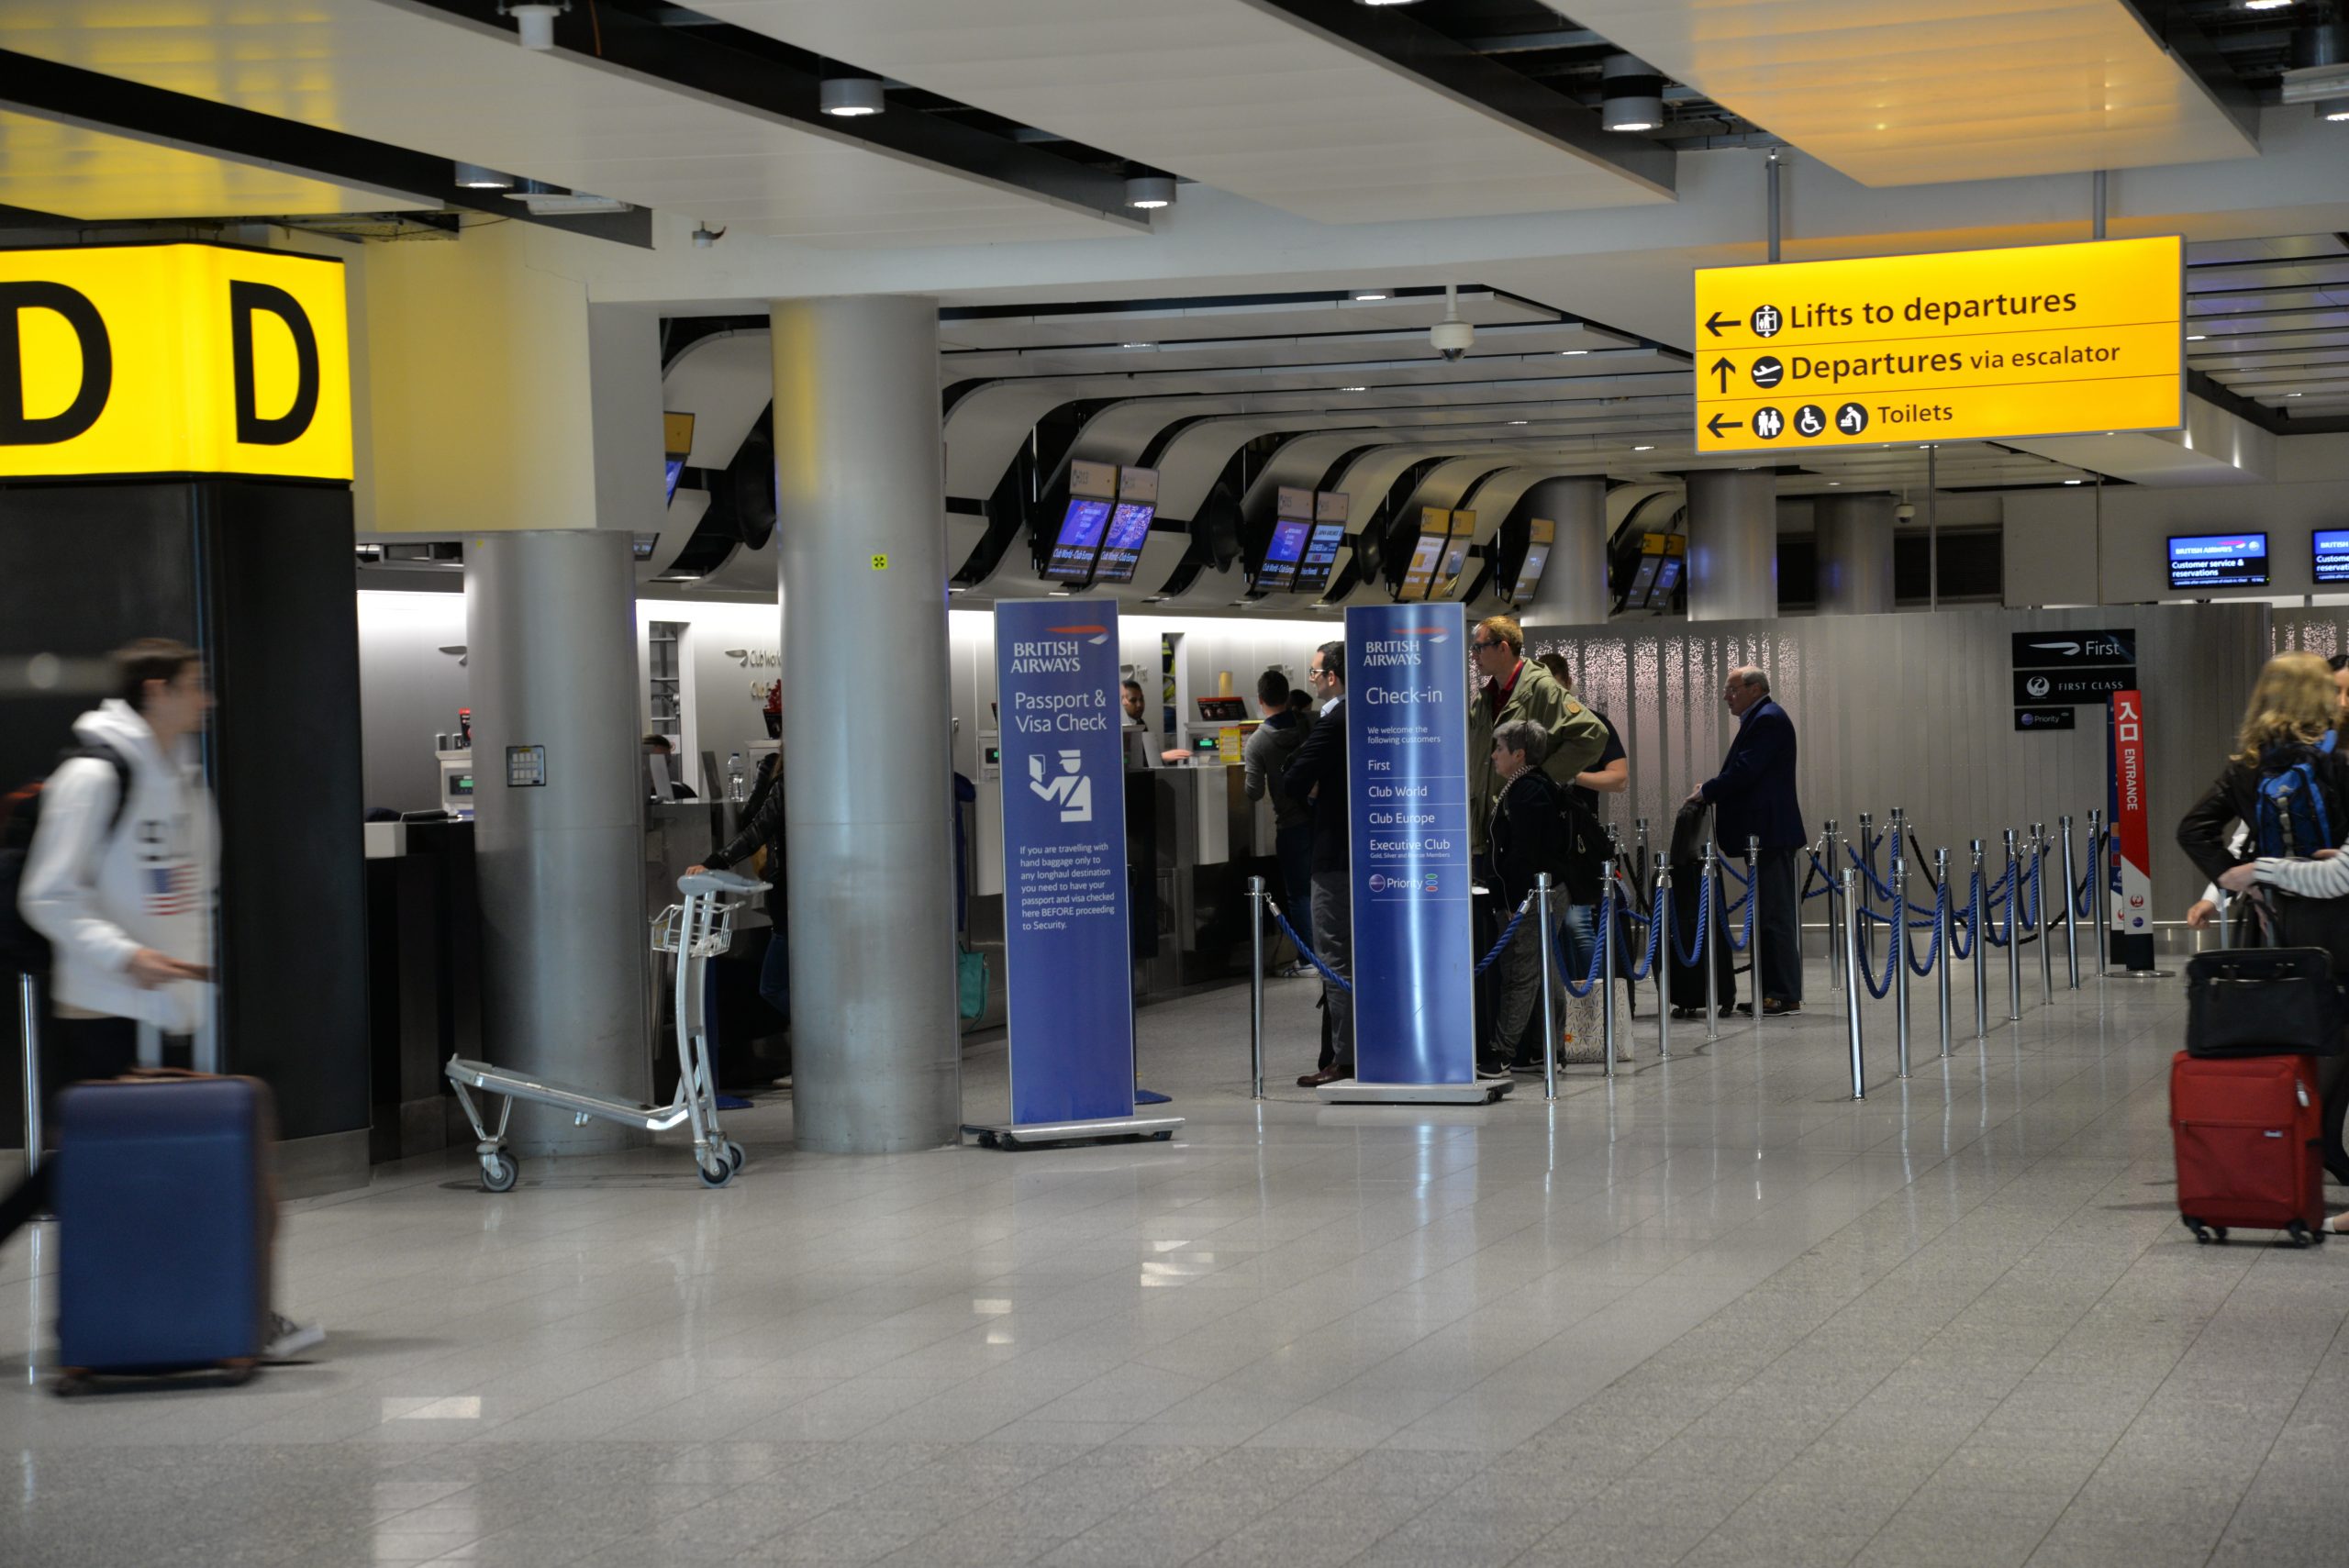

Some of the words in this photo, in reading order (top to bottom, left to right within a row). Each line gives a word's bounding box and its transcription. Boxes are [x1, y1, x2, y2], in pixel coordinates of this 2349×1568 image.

[1790, 302, 1854, 329] Lifts
[1863, 298, 1894, 325] to
[1904, 292, 2077, 325] departures
[0, 281, 113, 446] D
[229, 279, 319, 446] D
[1791, 352, 1963, 384] Departures
[1969, 350, 2005, 370] via
[2011, 344, 2121, 368] escalator
[1877, 403, 1954, 426] Toilets
[2172, 561, 2209, 570] Customer
[2210, 560, 2236, 568] service
[2237, 558, 2244, 566] &
[2172, 568, 2219, 578] reservations
[1014, 640, 1079, 657] BRITISH
[1365, 640, 1419, 653] BRITISH
[2086, 640, 2121, 656] First
[1010, 657, 1081, 673] AIRWAYS
[1364, 653, 1421, 666] AIRWAYS
[2058, 682, 2087, 691] FIRST
[2091, 681, 2124, 690] CLASS
[1015, 691, 1089, 712] Passport
[1095, 689, 1107, 707] &
[1365, 685, 1442, 705] Check-in
[1015, 715, 1052, 733] Visa
[1056, 713, 1108, 732] Check
[2034, 715, 2060, 724] Priority
[2119, 702, 2139, 742] 入口
[1380, 726, 1413, 734] welcome
[1367, 736, 1400, 745] following
[1401, 735, 1441, 744] customers
[1368, 760, 1391, 771] First
[2124, 749, 2138, 811] ENTRANCE
[1368, 786, 1393, 797] Club
[1395, 785, 1428, 797] World
[1369, 813, 1393, 824] Club
[1396, 812, 1435, 826] Europe
[1019, 846, 1026, 854] If
[1028, 847, 1042, 857] you
[1044, 846, 1056, 854] are
[1058, 843, 1092, 854] travelling
[1093, 842, 1108, 851] with
[1370, 840, 1421, 851] Executive
[1424, 839, 1451, 850] Club
[1020, 858, 1040, 867] hand
[1041, 857, 1074, 868] baggage
[1074, 856, 1091, 866] only
[1093, 856, 1101, 864] to
[1020, 873, 1035, 882] any
[1037, 871, 1070, 881] longhaul
[1071, 868, 1111, 877] destination
[1021, 885, 1036, 895] you
[1039, 884, 1058, 892] need
[1069, 882, 1087, 890] have
[1089, 882, 1105, 891] your
[1386, 877, 1423, 891] Priority
[1021, 896, 1054, 906] passport
[1056, 895, 1070, 904] and
[1071, 894, 1085, 902] visa
[1086, 893, 1115, 902] checked
[1022, 908, 1040, 917] here
[1041, 907, 1074, 917] BEFORE
[1075, 906, 1115, 916] proceeding
[1033, 921, 1067, 930] Security.
